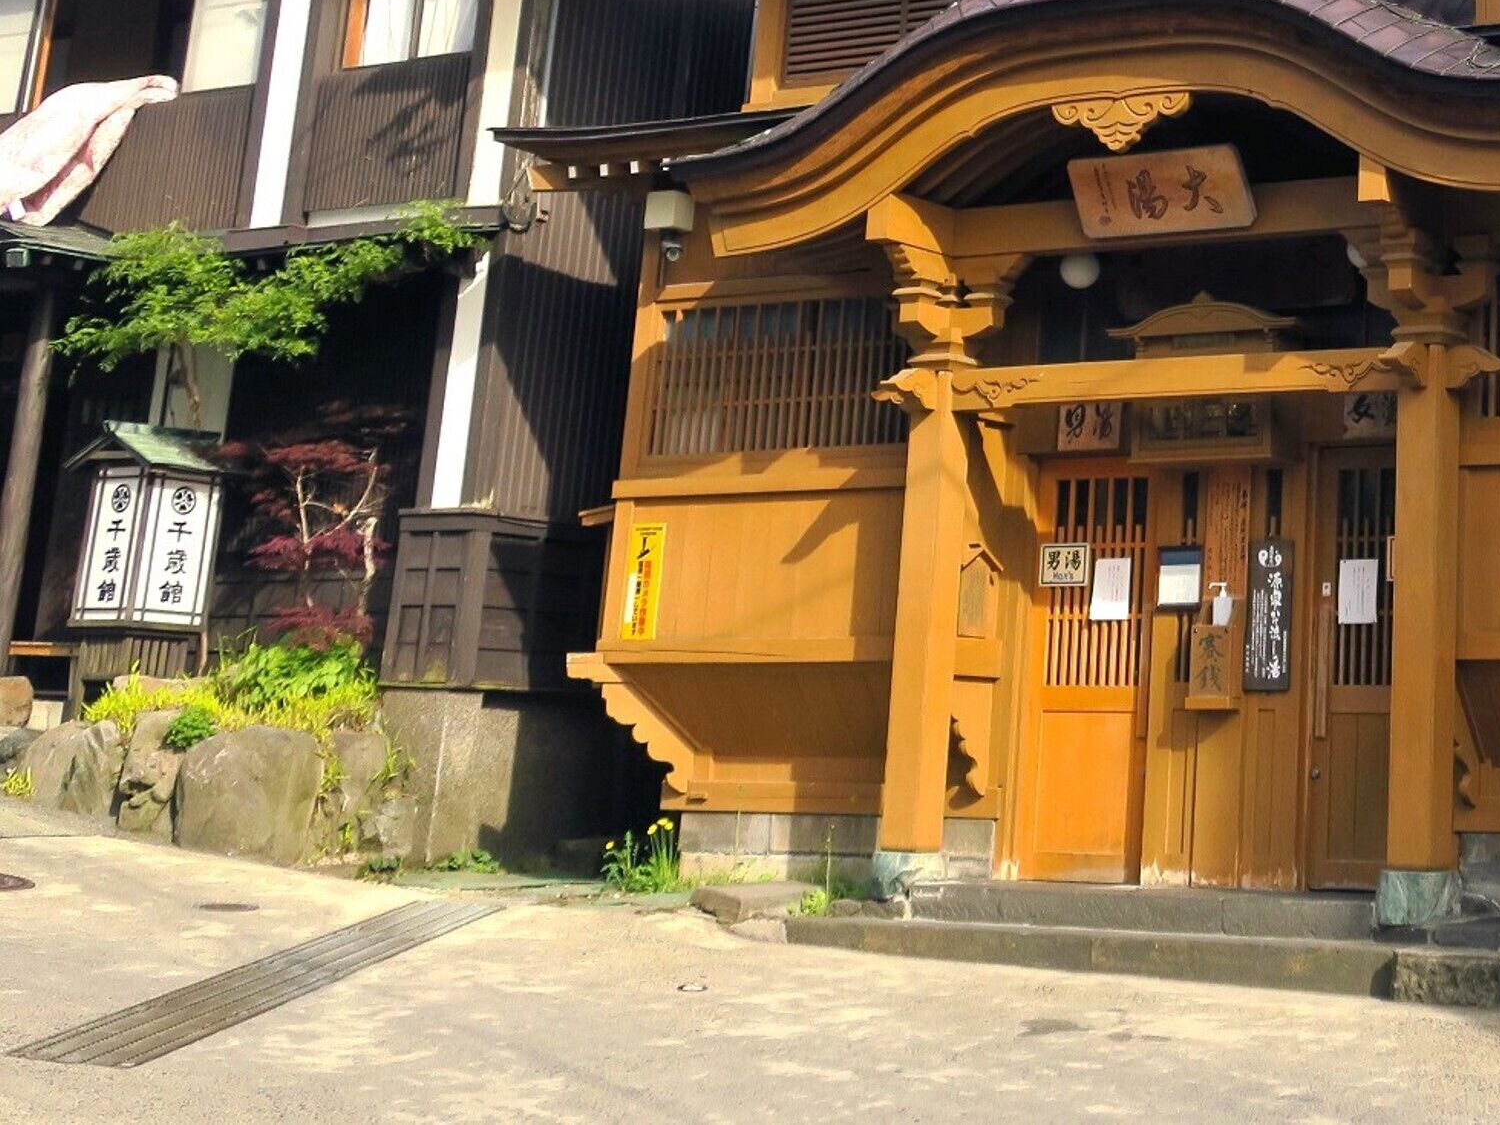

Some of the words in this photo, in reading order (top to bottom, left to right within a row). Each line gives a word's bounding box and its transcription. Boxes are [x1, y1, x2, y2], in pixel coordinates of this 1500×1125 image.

[98, 519, 126, 602] 千歳館
[159, 521, 192, 604] 千歳館
[1046, 549, 1082, 571] 男湯
